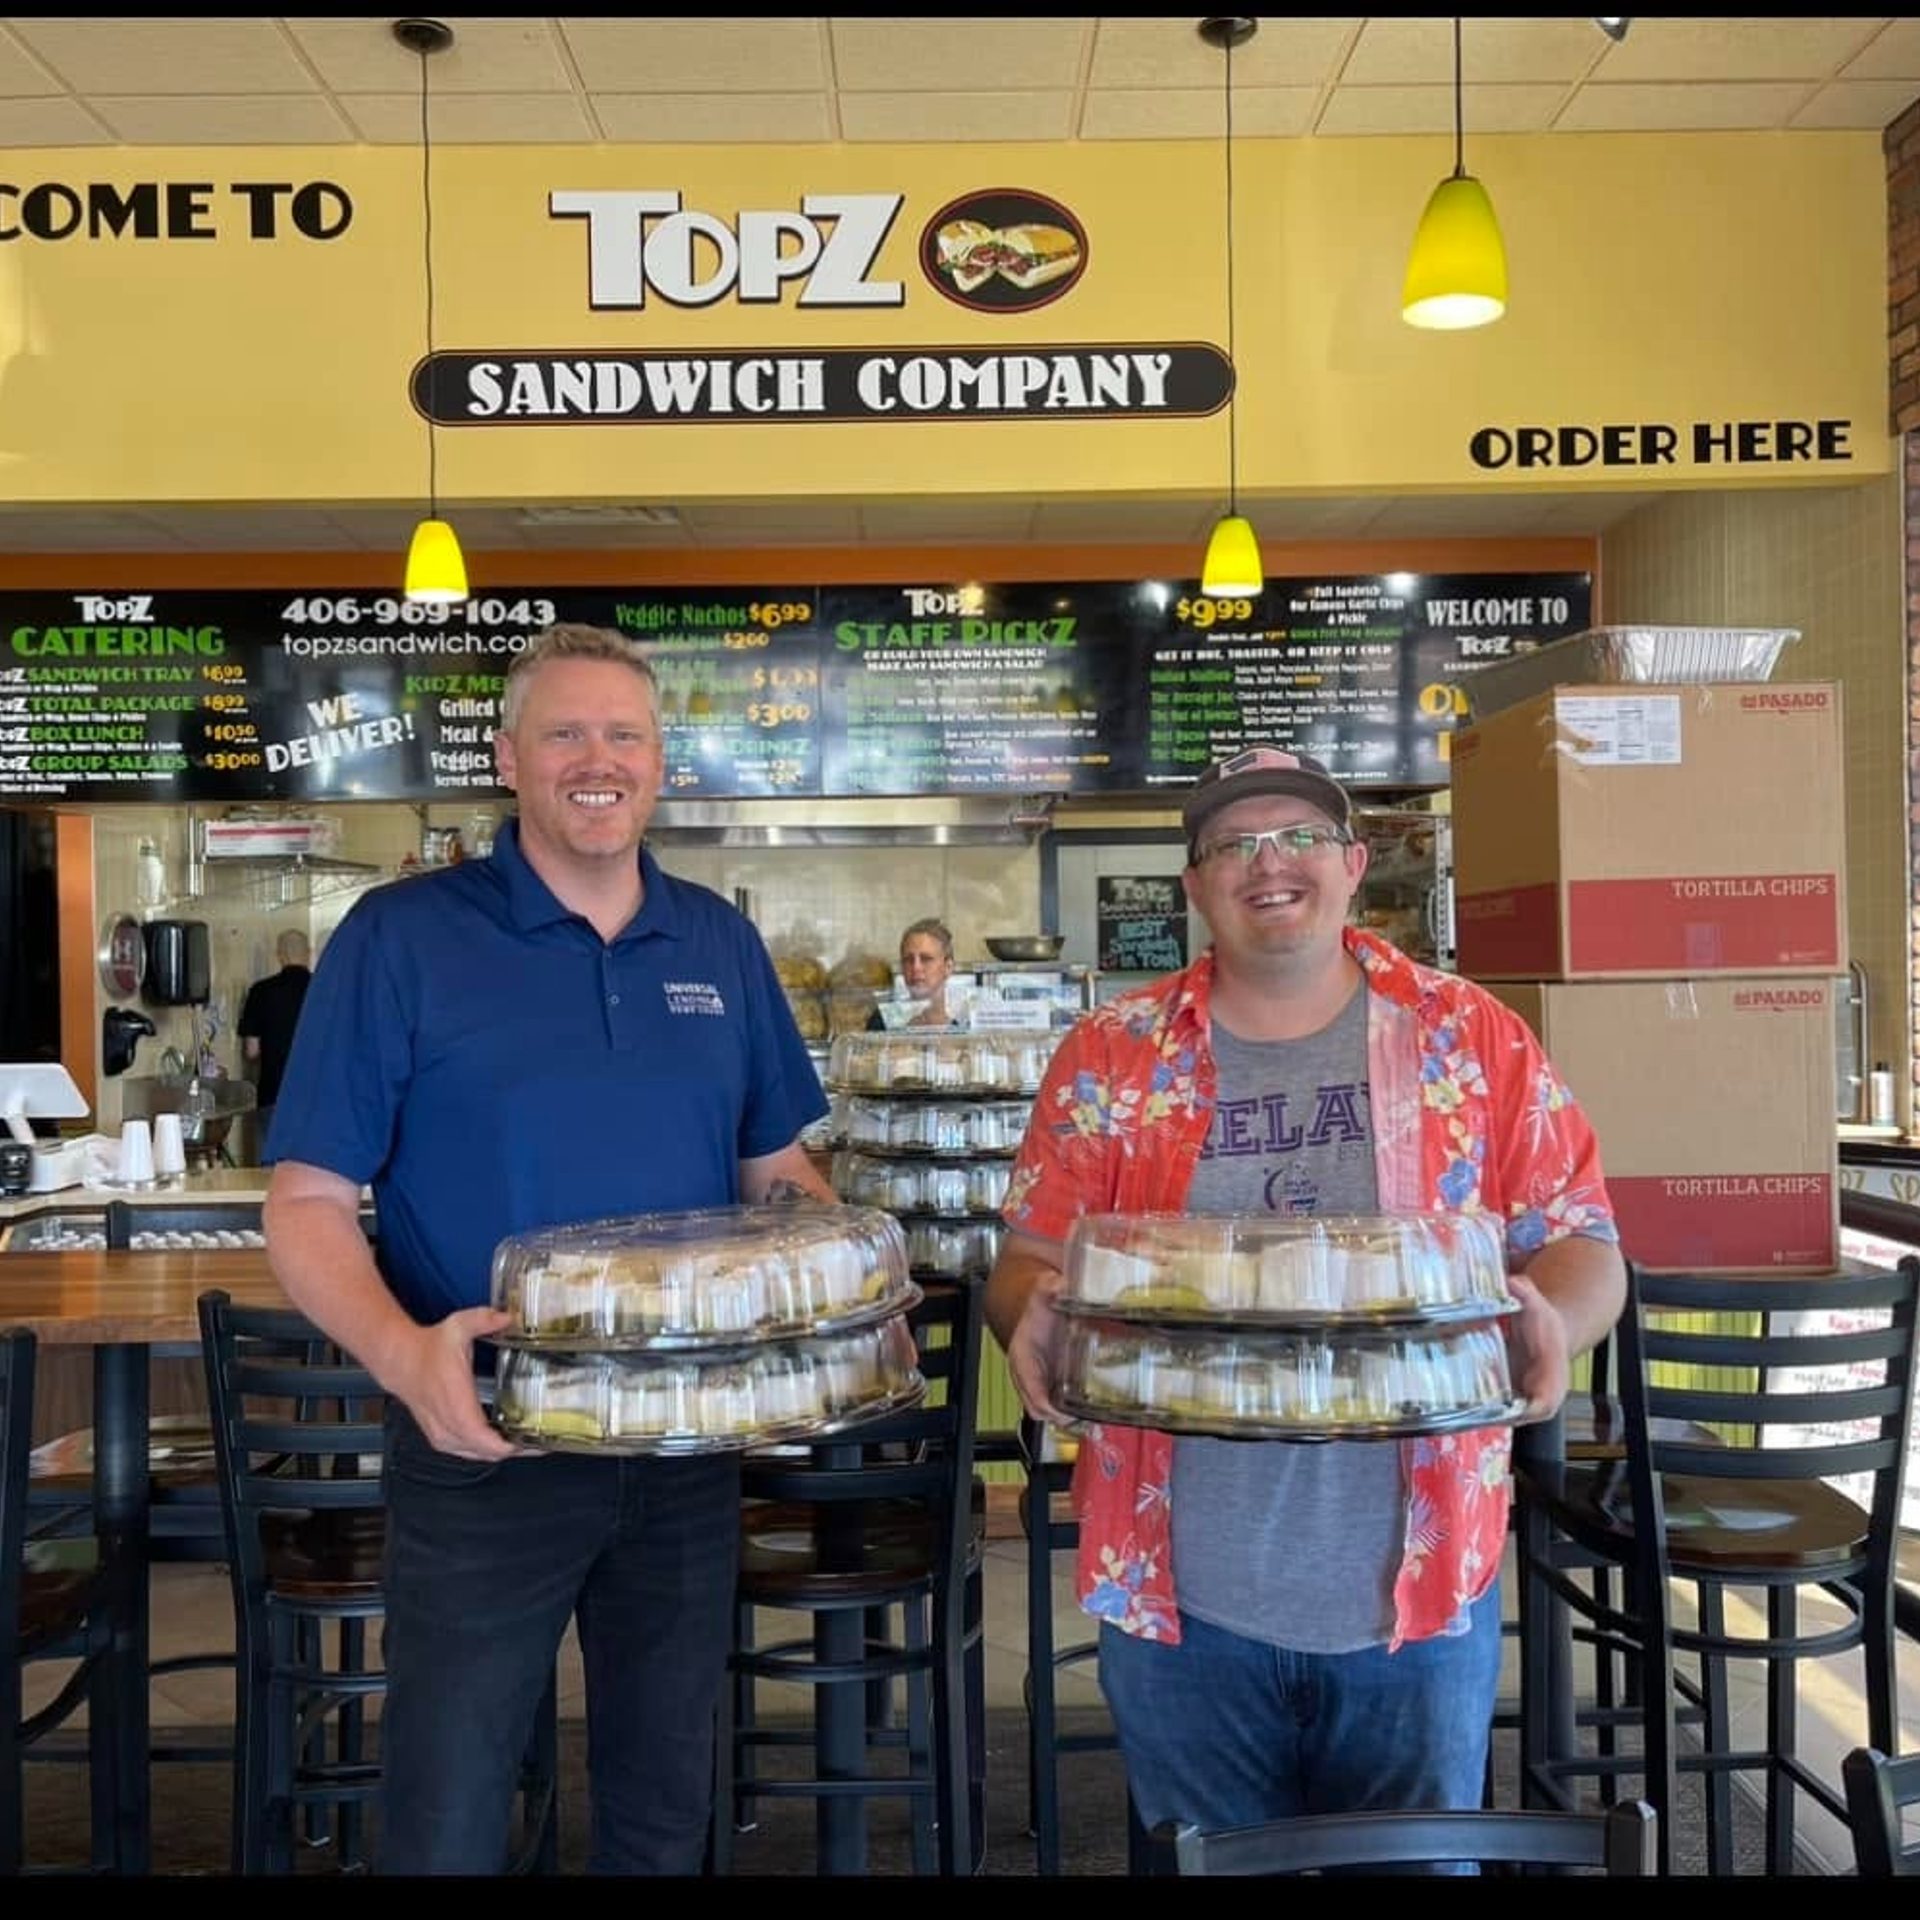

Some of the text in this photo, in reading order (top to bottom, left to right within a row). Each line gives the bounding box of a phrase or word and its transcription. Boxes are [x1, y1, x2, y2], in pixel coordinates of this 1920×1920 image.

[231, 181, 353, 240] TO
[468, 351, 1174, 417] SANDWICH COMPANY
[1470, 421, 1852, 469] ORDER HERE
[281, 598, 556, 625] 406-969-1043
[616, 603, 677, 629] Veggie
[681, 603, 747, 626] Nachos
[1426, 598, 1568, 627] WELCOME TO
[12, 626, 225, 656] CATERING
[835, 617, 1078, 650] STAFF PICKZ
[28, 667, 137, 682] SANDWICH
[141, 667, 195, 682] TRAY
[405, 675, 507, 694] KIDZ ME
[30, 697, 97, 711] TOTAL
[101, 697, 196, 711] PACKAGE
[306, 693, 364, 728] WE
[440, 698, 493, 717] Grilled
[1759, 692, 1827, 708] PASADO
[30, 726, 73, 741] BOX
[76, 725, 144, 741] LUNCH
[265, 713, 415, 773] DELIVER!
[441, 726, 478, 743] Meat
[32, 756, 105, 770] GROUP
[107, 756, 189, 770] SALADS
[430, 751, 490, 772] Veggies
[1671, 878, 1829, 898] TORTILLA CHIPS
[1753, 990, 1823, 1005] PASADO
[1200, 1082, 1370, 1160] ELA
[1665, 1178, 1760, 1197] TORTILLA
[1763, 1177, 1821, 1195] CHIPS
